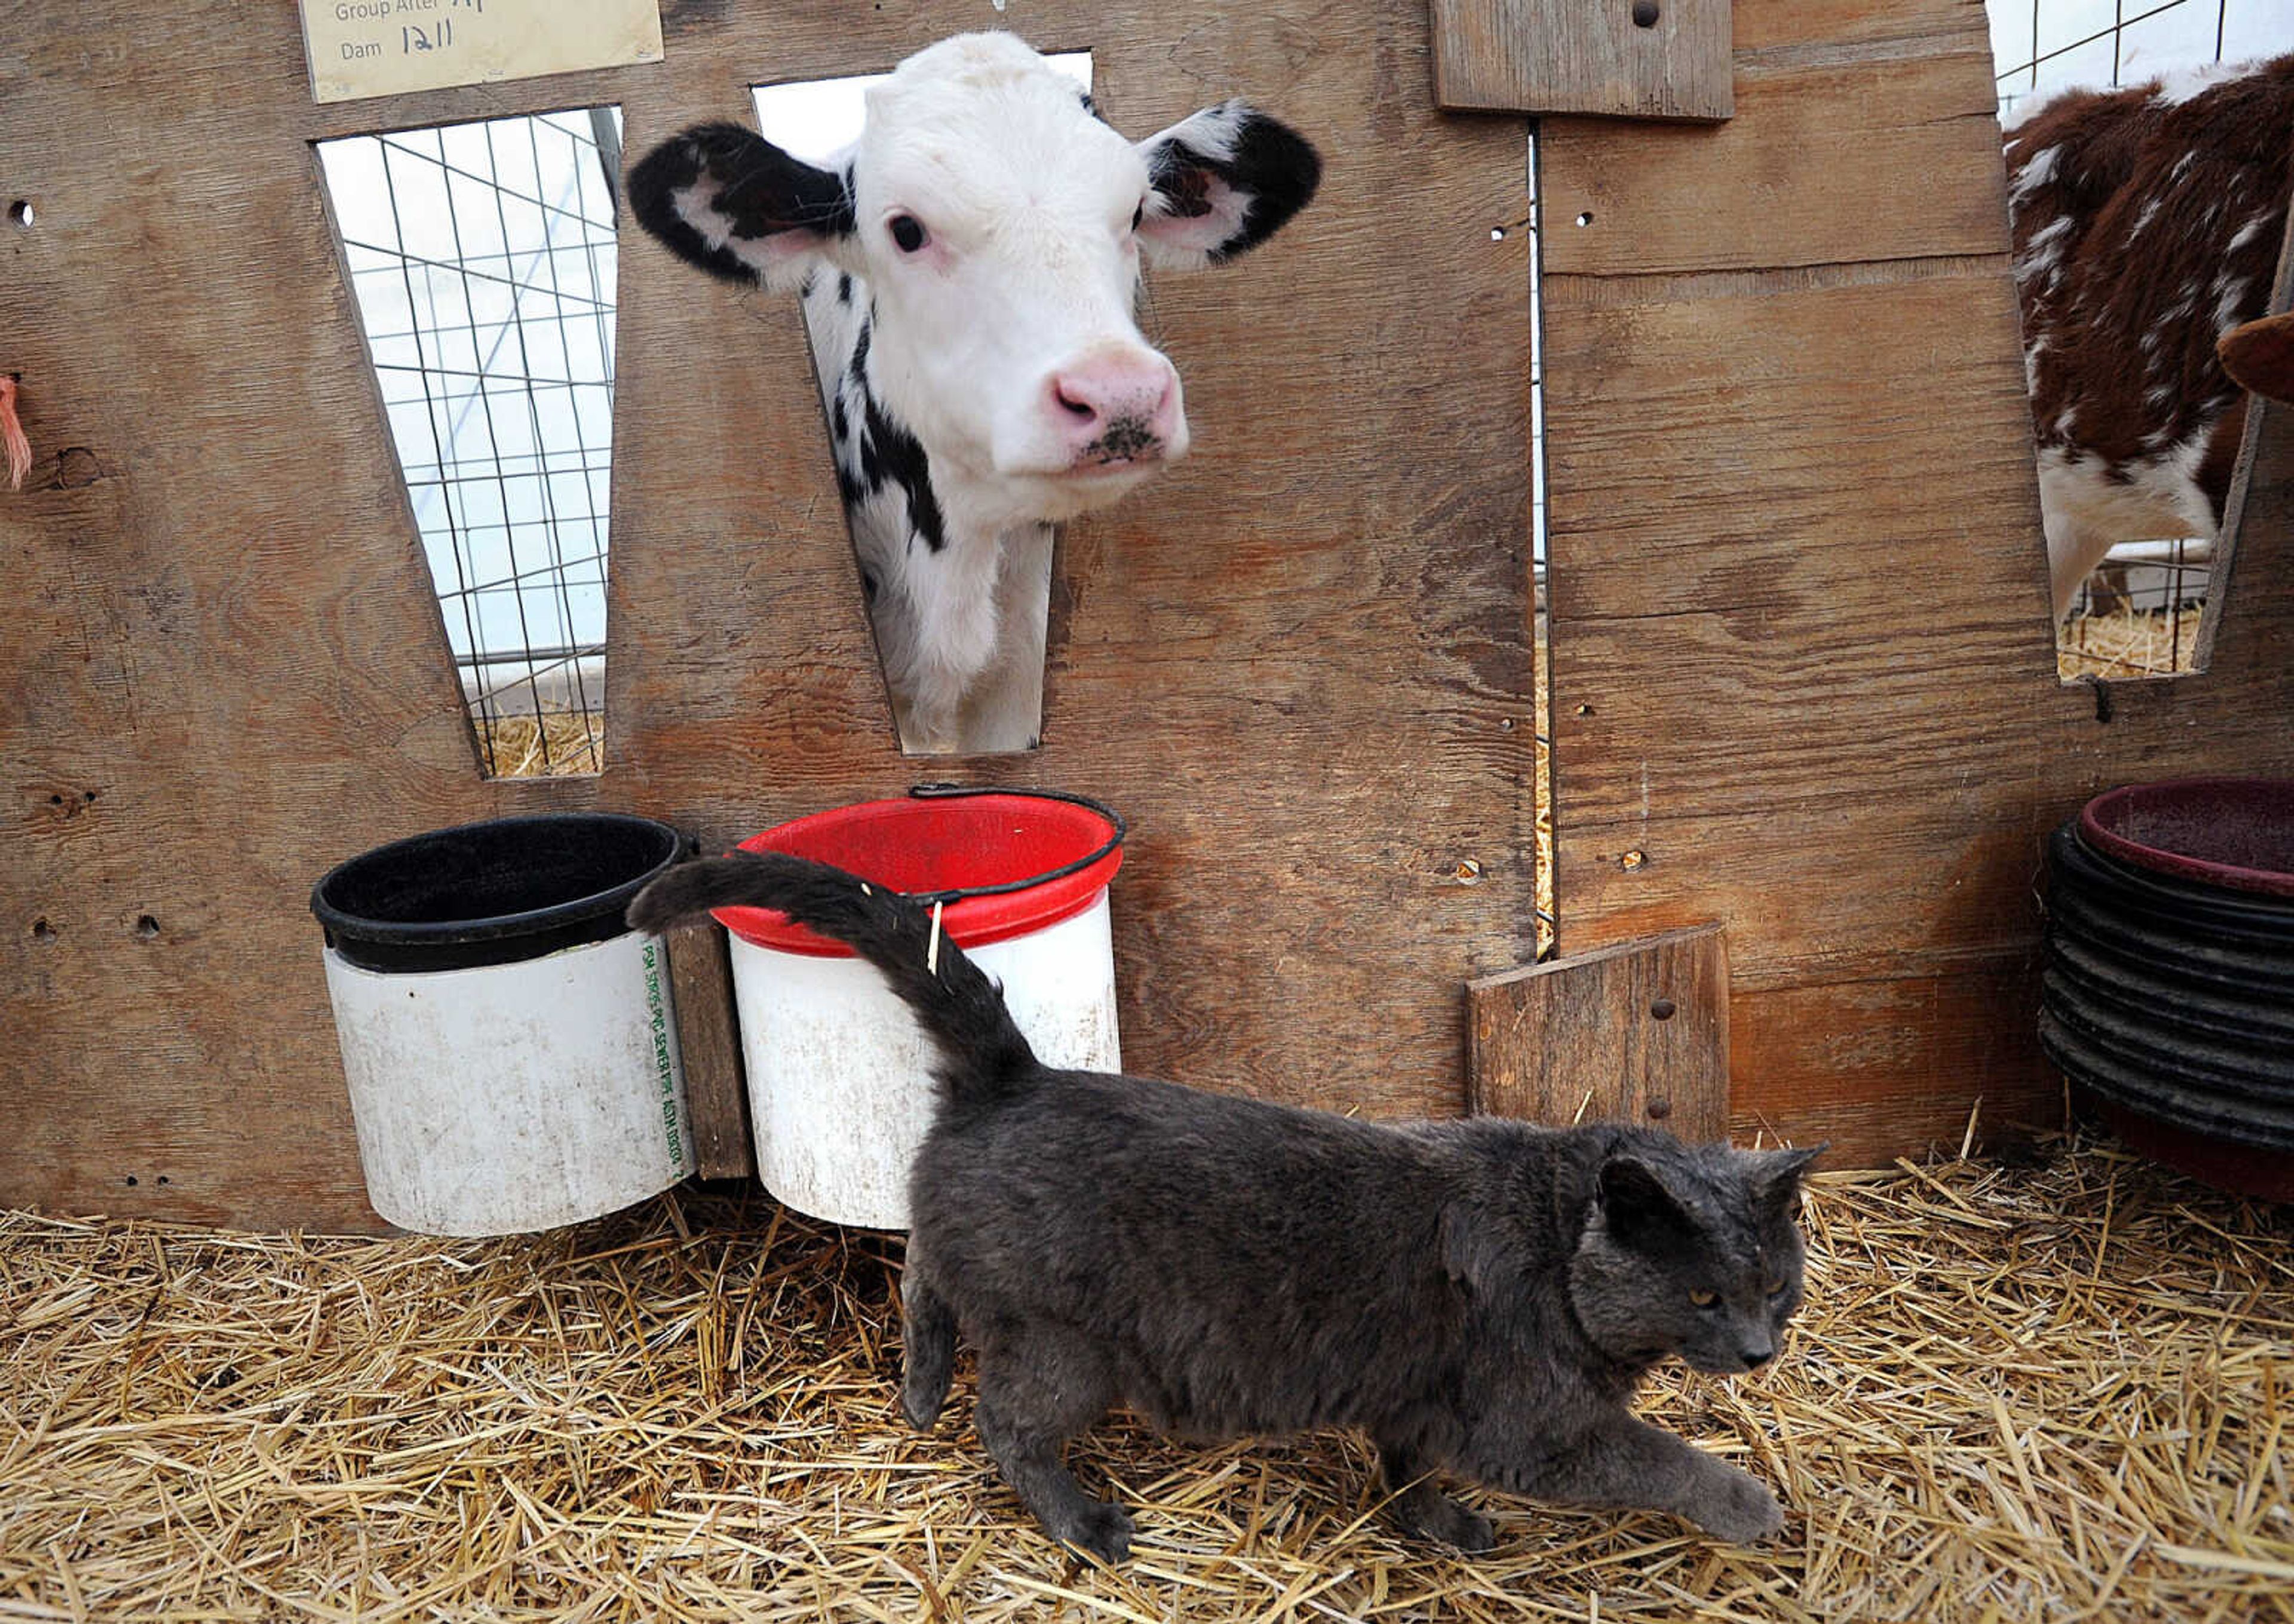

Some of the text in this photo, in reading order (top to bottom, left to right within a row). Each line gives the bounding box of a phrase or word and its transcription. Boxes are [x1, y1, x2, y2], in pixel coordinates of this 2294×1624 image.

[335, 1, 391, 21] Group
[341, 18, 452, 60] Dam 1211
[655, 1033, 670, 1072] SEWER
